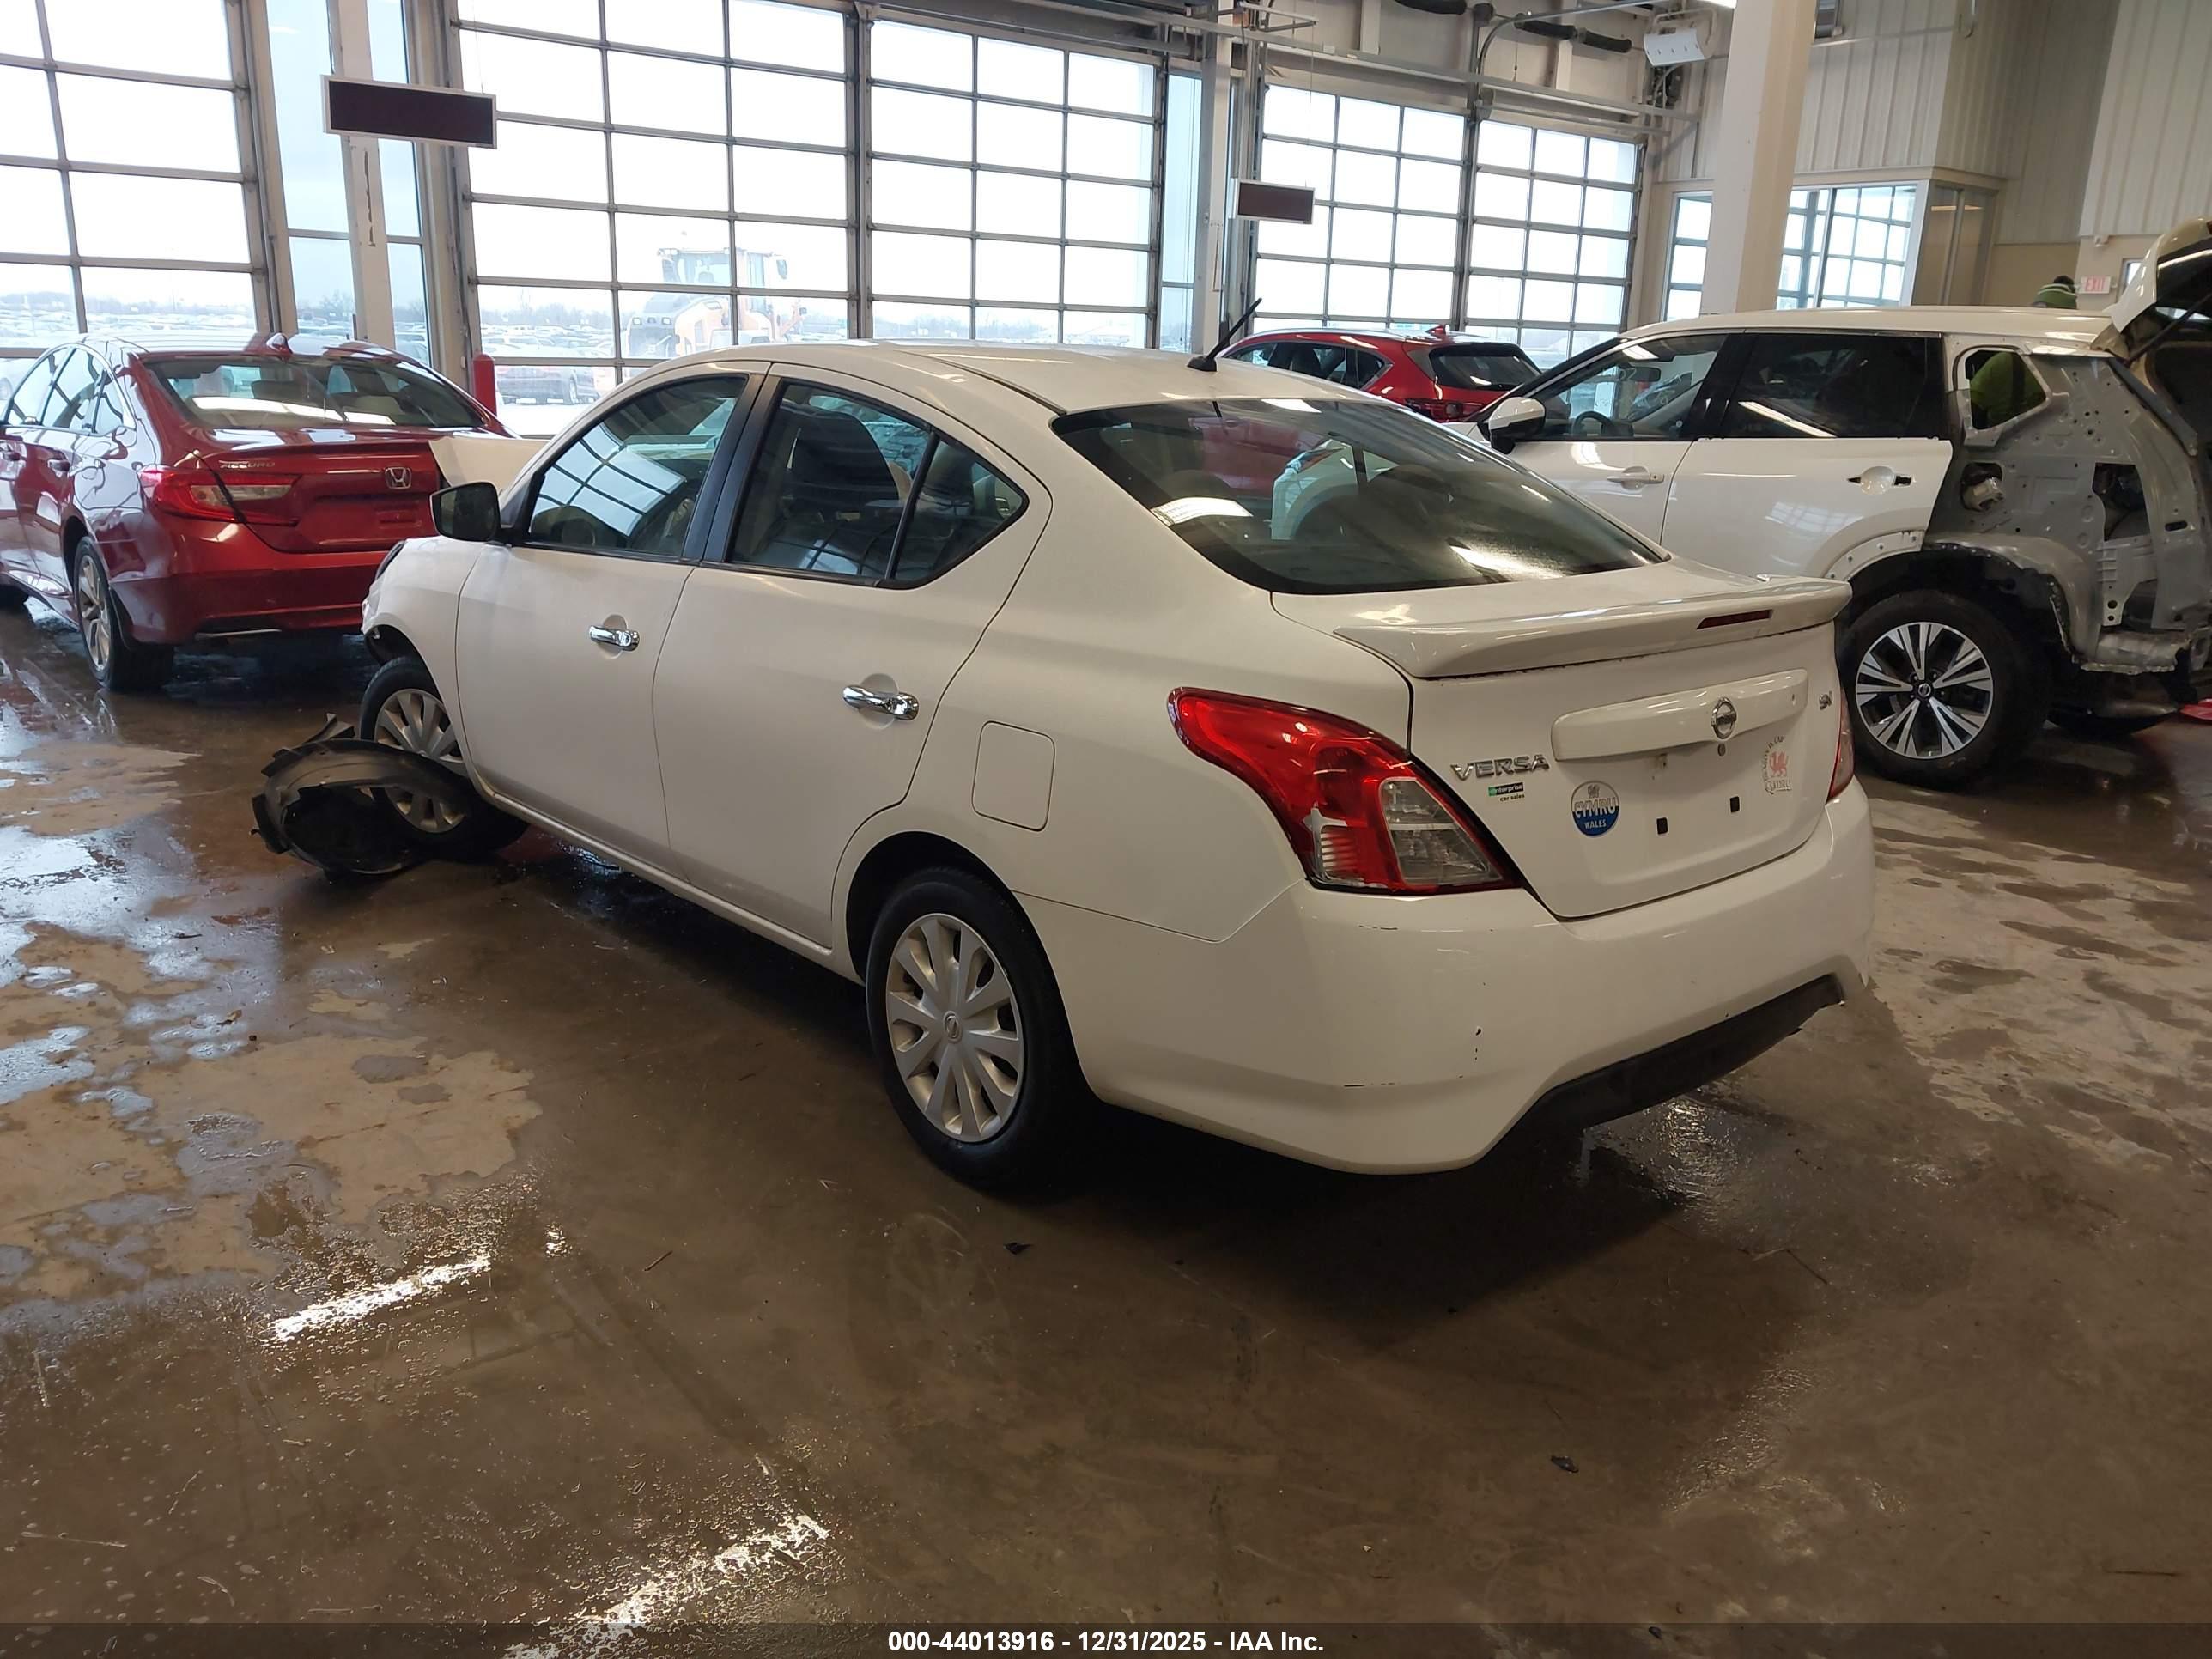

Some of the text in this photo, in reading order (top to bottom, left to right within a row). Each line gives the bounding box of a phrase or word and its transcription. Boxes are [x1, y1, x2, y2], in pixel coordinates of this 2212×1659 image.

[2084, 276, 2106, 292] EXIT
[1450, 754, 1550, 781] VERSA
[1574, 797, 1617, 819] CYMRU
[1584, 819, 1607, 830] WALES
